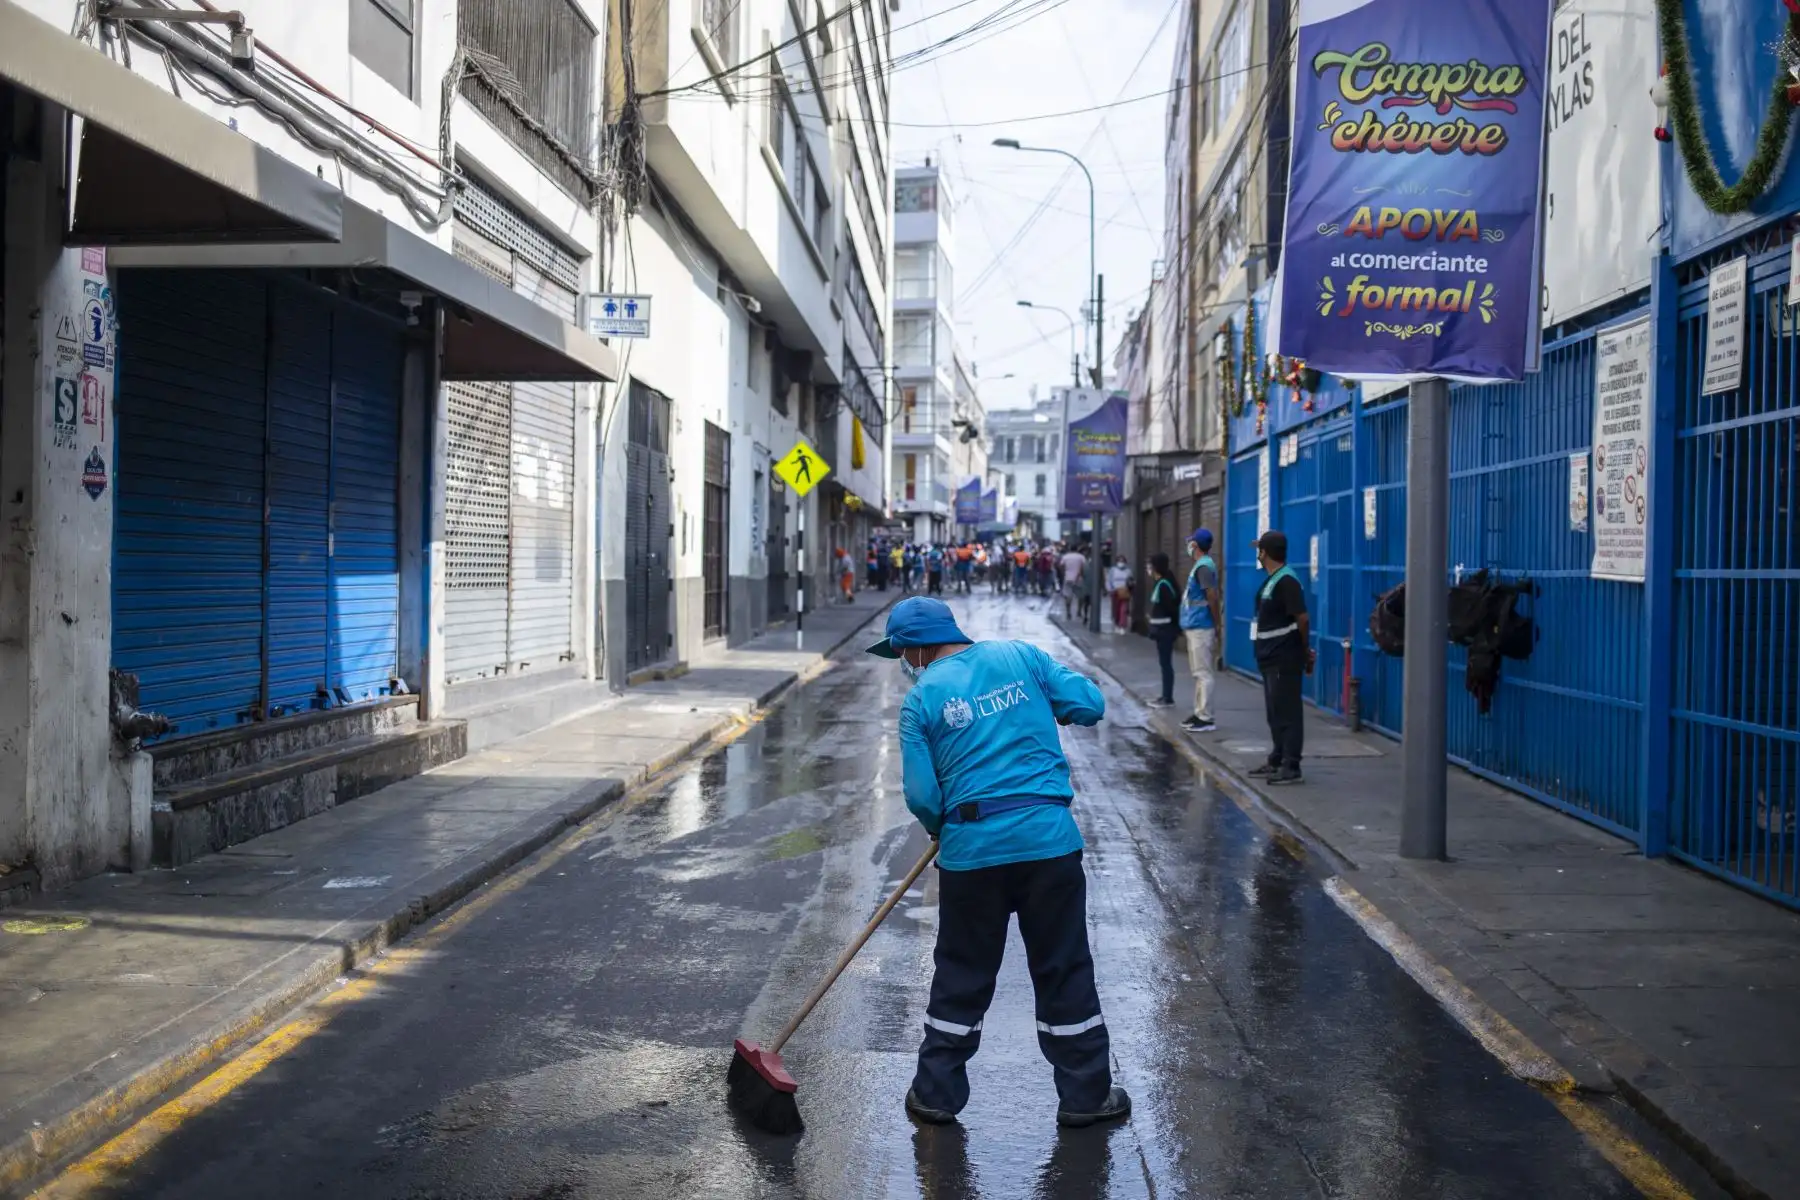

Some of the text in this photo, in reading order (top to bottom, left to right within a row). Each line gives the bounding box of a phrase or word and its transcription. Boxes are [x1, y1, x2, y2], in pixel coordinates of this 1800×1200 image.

[1559, 13, 1591, 74] DEL
[1313, 42, 1526, 104] Compra
[1549, 60, 1594, 132] YLAS
[1331, 109, 1508, 155] chévere
[1344, 206, 1480, 242] APOYA
[1331, 252, 1488, 273] al comerciante
[1338, 275, 1476, 316] formal
[980, 688, 1029, 716] LIMA
